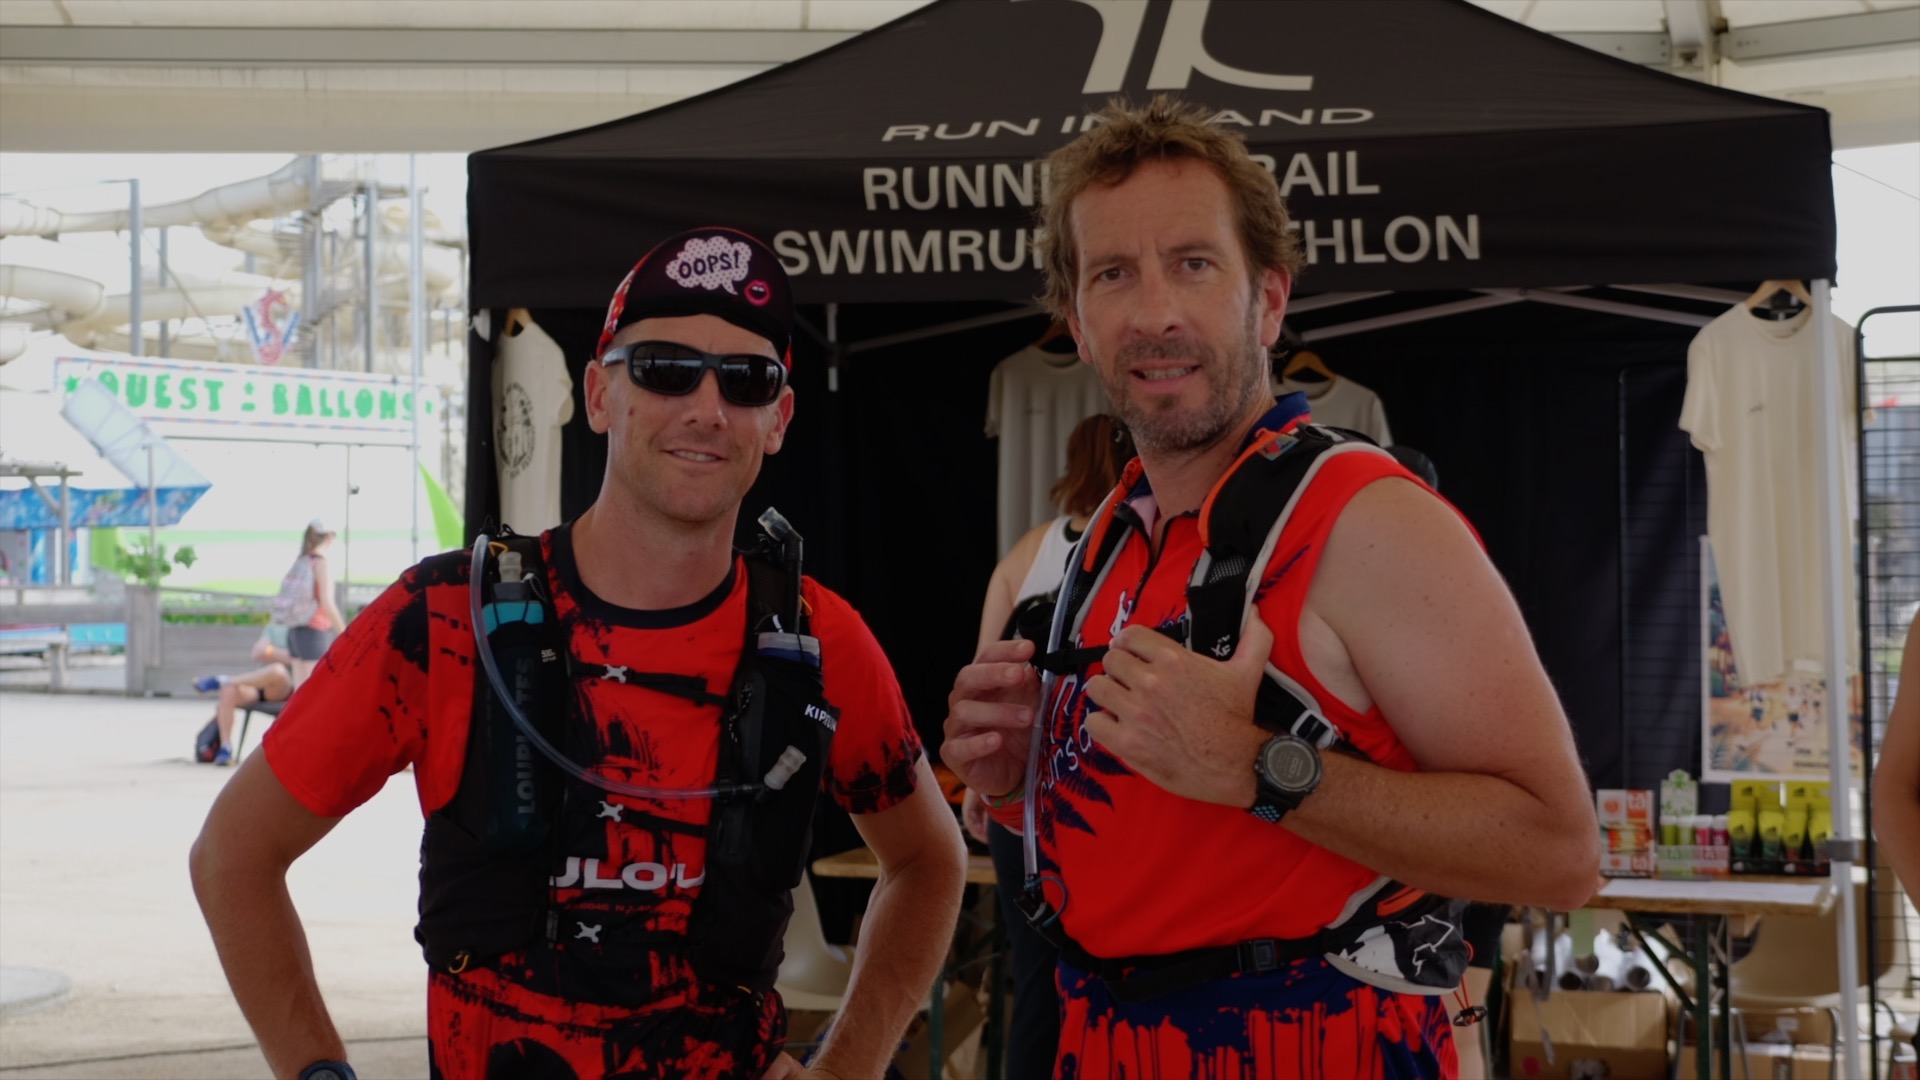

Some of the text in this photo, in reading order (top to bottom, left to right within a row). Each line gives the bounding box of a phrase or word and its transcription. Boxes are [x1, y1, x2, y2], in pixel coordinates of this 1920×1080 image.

[881, 117, 1041, 142] RUN
[1204, 107, 1375, 127] AND
[863, 150, 1381, 211] RUNNI AIL
[1285, 214, 1481, 264] HLON
[679, 250, 740, 279] OOPS!
[515, 656, 537, 814] LOUPITES
